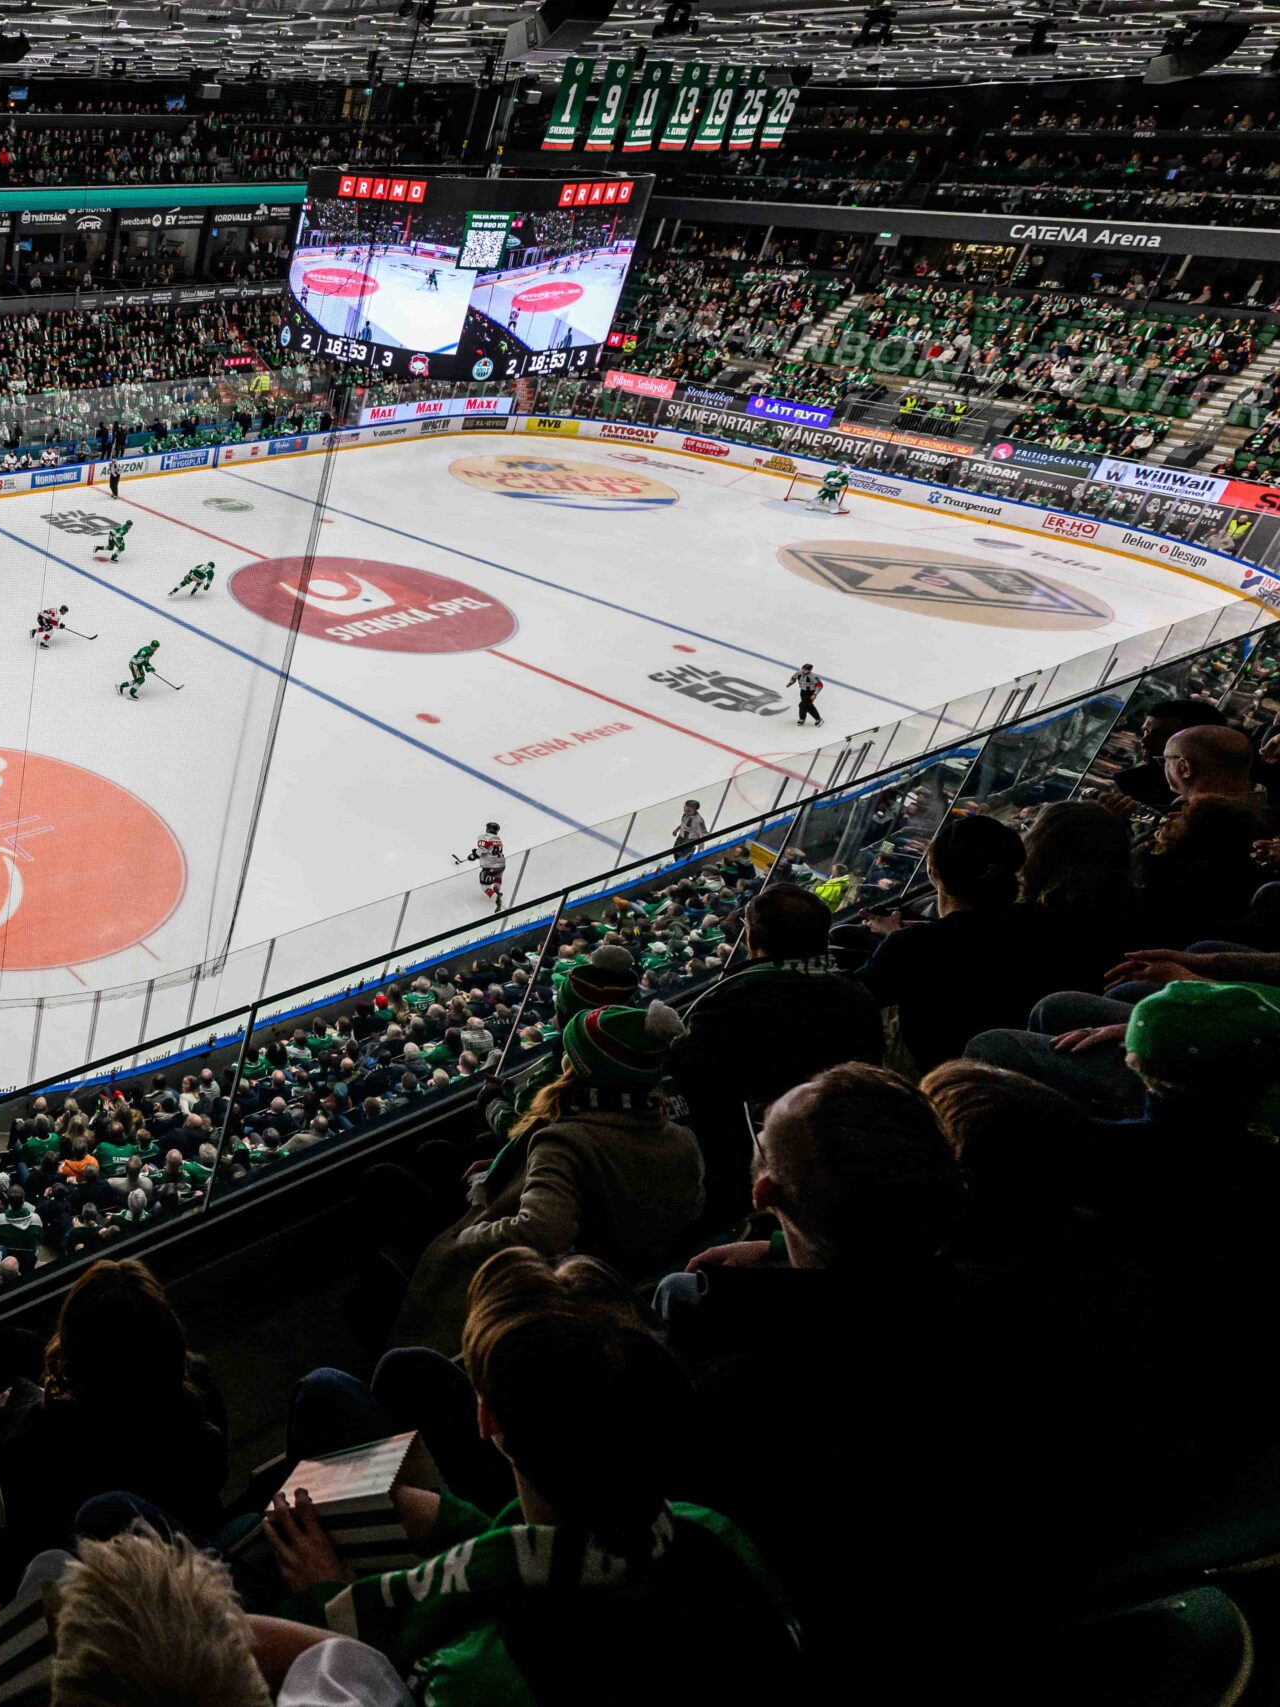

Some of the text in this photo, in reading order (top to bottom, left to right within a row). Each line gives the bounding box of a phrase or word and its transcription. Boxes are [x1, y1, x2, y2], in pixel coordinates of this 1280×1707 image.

[560, 83, 577, 122] 1
[601, 85, 622, 124] 9
[635, 88, 658, 126] 11
[670, 87, 700, 124] 13
[706, 88, 733, 125] 19
[735, 89, 768, 125] 25
[767, 88, 800, 123] 26
[342, 180, 423, 200] CRAMO
[562, 187, 630, 203] CRAMO
[165, 215, 177, 225] EY
[1009, 223, 1162, 249] CATENA Arena
[301, 334, 312, 349] 2
[325, 339, 367, 360] 18:53
[382, 351, 393, 366] 3
[506, 359, 517, 374] 2
[528, 353, 566, 371] 18:53
[577, 350, 587, 365] 3
[466, 399, 498, 409] MAXI
[686, 386, 734, 403] Stenbutiken
[370, 408, 396, 419] MAXI
[416, 403, 443, 414] MAXI
[765, 403, 827, 423] LÄTT FLYTT
[378, 428, 406, 437] BAUER
[421, 420, 441, 430] IMPACT
[538, 419, 561, 429] MVB
[601, 425, 658, 439] FLYTGOLV
[1015, 449, 1097, 471] FRITIDSCENTER
[970, 463, 1020, 480] STÄDAX
[1134, 467, 1216, 492] WillWall
[1023, 477, 1067, 492] stadax.nu
[943, 495, 1002, 516] Tranpenad
[1162, 500, 1225, 520] STÄDAX
[1047, 516, 1096, 535] ER-HO
[1055, 528, 1080, 538] BYGG
[1028, 549, 1103, 572] Telia
[1122, 533, 1158, 551] Dekor
[1169, 545, 1207, 568] Design
[325, 596, 494, 642] SVENSKA SPEL
[647, 664, 721, 689] SHL
[674, 675, 783, 715] 50
[493, 720, 634, 768] CATENA Arena
